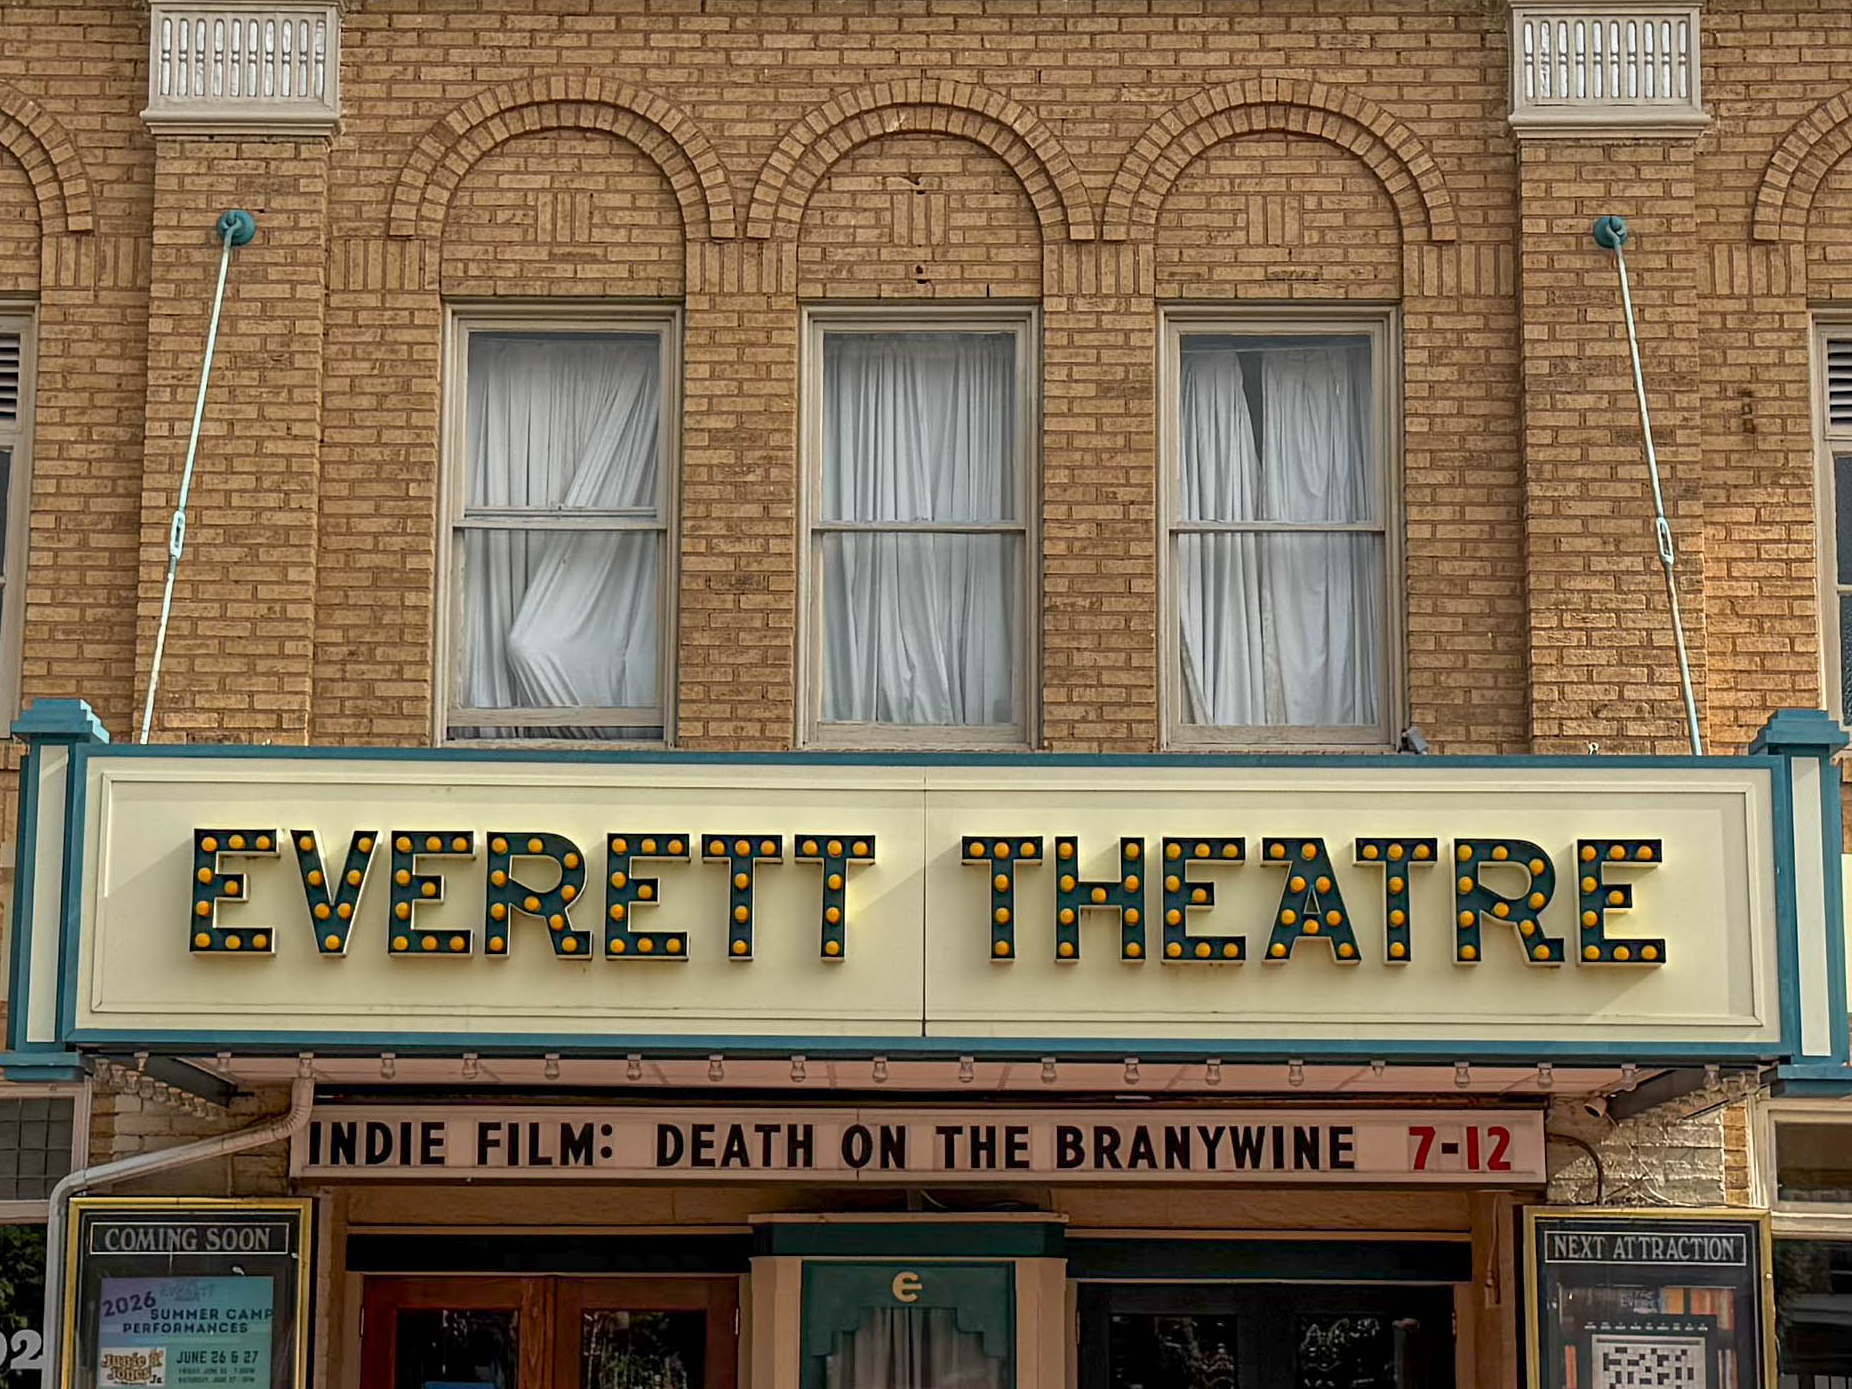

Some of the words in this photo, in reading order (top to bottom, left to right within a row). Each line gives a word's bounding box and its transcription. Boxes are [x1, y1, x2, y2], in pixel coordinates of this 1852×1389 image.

[187, 827, 876, 961] EVERETT
[961, 835, 1667, 968] THEATRE
[308, 1120, 445, 1166] INDIE
[476, 1121, 615, 1167] FILM:
[656, 1123, 813, 1169] DEATH
[842, 1122, 909, 1170] ON
[935, 1124, 1032, 1170] THE
[1056, 1124, 1356, 1171] BRANYWINE
[1407, 1125, 1514, 1172] 7-12
[105, 1228, 198, 1251] COMING
[205, 1228, 270, 1251] SOON
[1554, 1236, 1605, 1259] NEXT
[1613, 1237, 1734, 1260] ATTRACTION
[102, 1291, 157, 1317] 2026
[150, 1309, 219, 1320] SUMMER
[226, 1309, 275, 1320] CAMP
[123, 1322, 249, 1334] PERFORMANCES
[176, 1351, 207, 1364] JUNE
[211, 1351, 227, 1364] 26
[244, 1351, 259, 1364] 27
